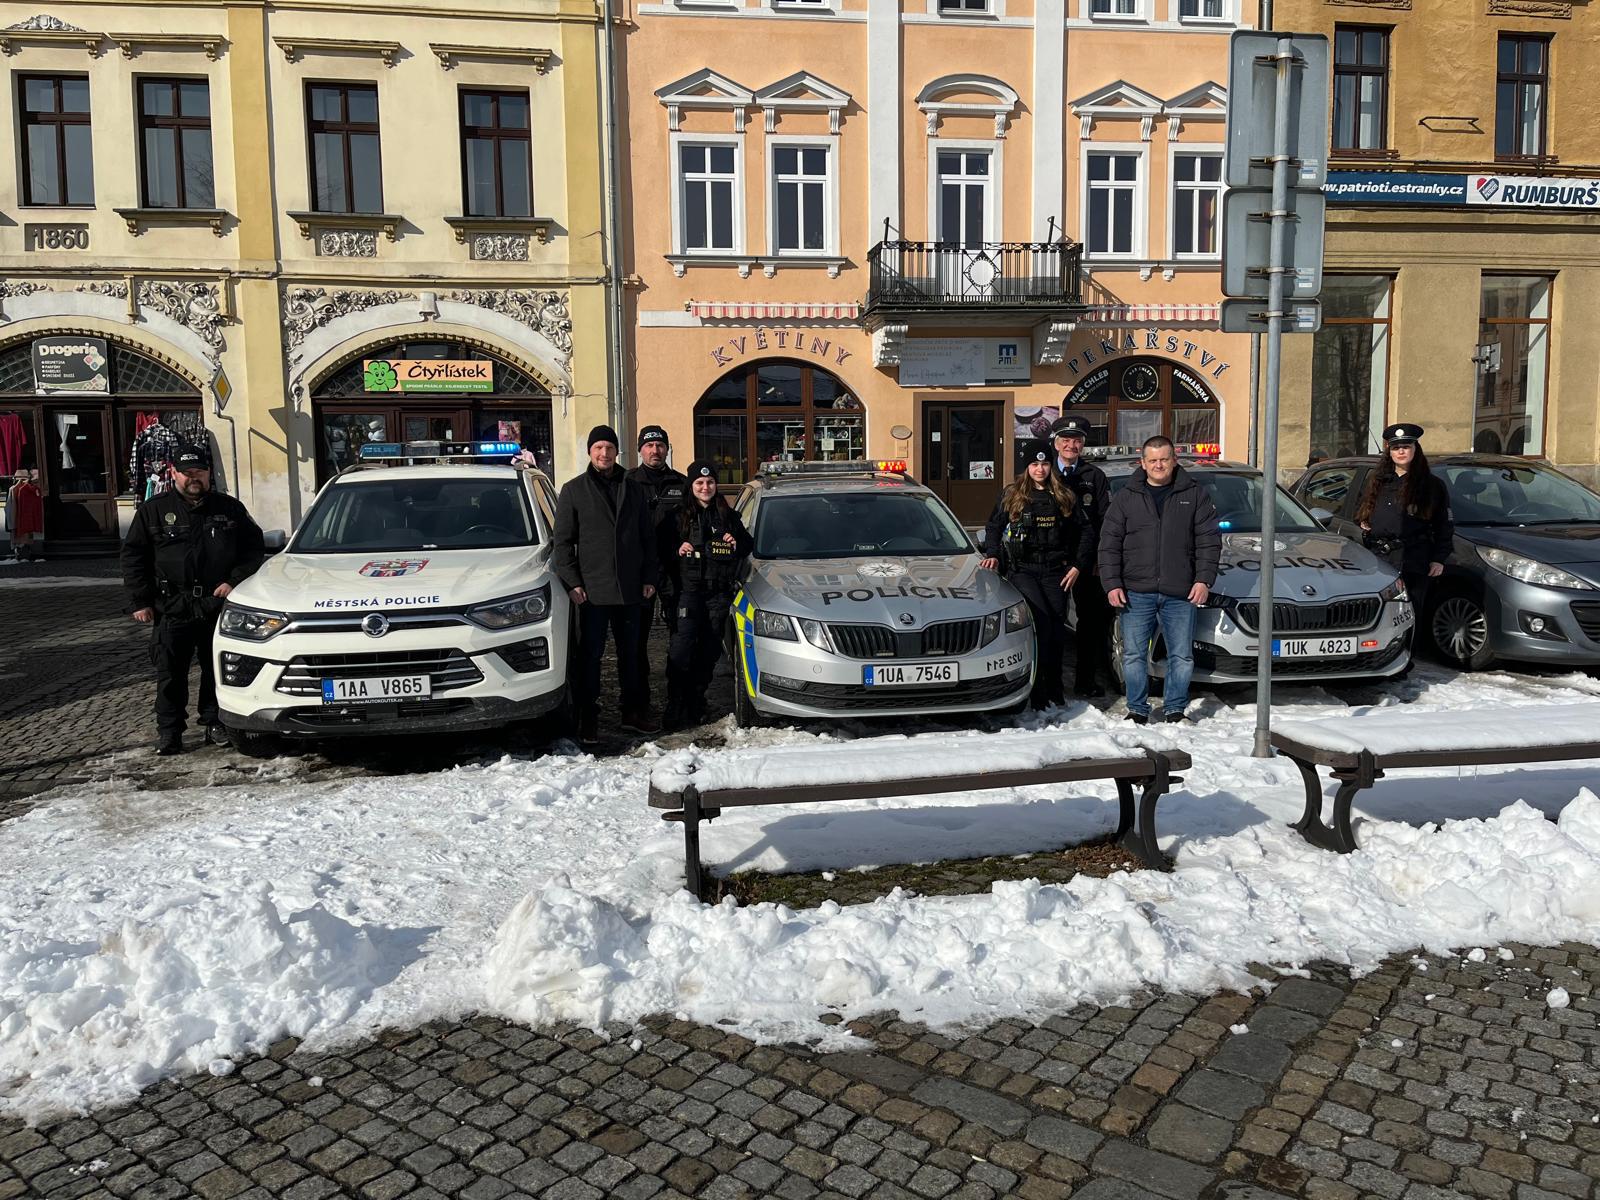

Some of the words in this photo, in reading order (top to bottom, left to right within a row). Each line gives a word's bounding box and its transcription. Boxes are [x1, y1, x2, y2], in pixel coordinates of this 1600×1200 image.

[1501, 181, 1600, 205] RUMBURŠ
[33, 226, 90, 249] 1860
[39, 342, 98, 356] Drogerie
[710, 326, 852, 367] KVĚTINY
[1067, 327, 1230, 379] PEKAŘSTVÍ
[408, 361, 487, 380] Čtyřlístek
[314, 597, 379, 608] MĚSTSKÁ
[384, 595, 440, 606] POLICIE
[822, 585, 974, 605] POLICIE
[1284, 641, 1308, 655] 1UK
[1319, 639, 1351, 654] 4823
[878, 667, 904, 683] 1UA
[916, 665, 951, 682] 7546
[338, 681, 368, 697] 1AA
[381, 678, 422, 695] V865
